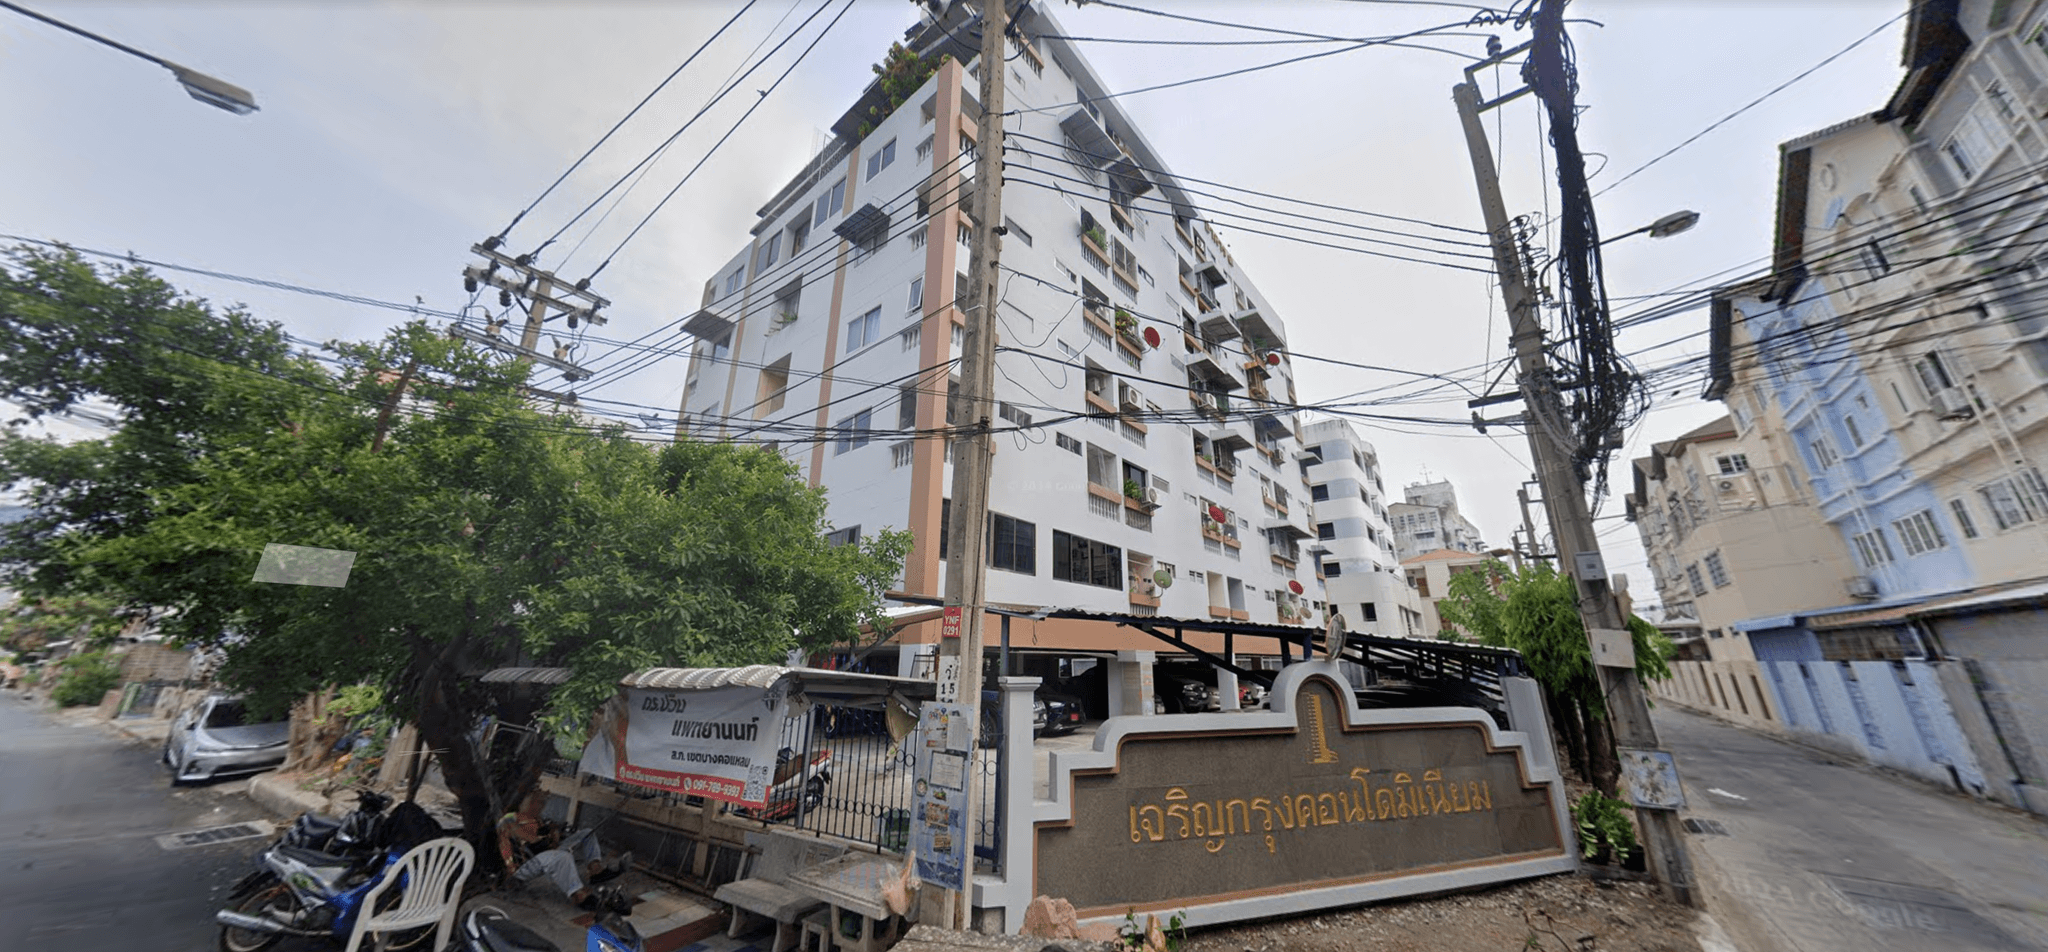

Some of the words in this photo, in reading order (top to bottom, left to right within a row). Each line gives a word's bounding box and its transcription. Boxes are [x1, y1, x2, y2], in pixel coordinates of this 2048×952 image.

[945, 615, 960, 625] YNF
[1129, 767, 1492, 854] เจริญกรุงคอนโดมิเนียม
